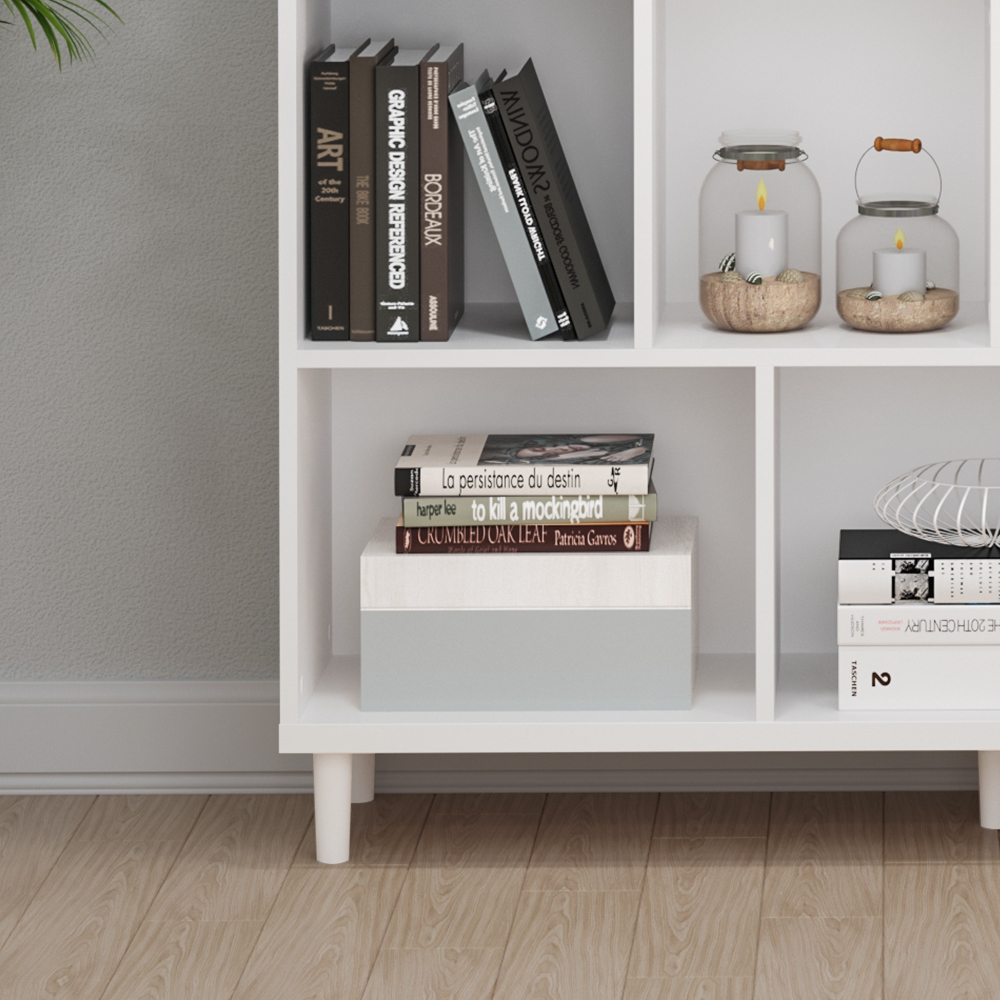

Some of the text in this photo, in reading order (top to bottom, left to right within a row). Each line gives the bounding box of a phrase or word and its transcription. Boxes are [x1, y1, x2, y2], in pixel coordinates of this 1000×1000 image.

[388, 89, 406, 149] GRAPHIC
[317, 127, 343, 171] ART
[356, 175, 369, 188] THE
[388, 151, 406, 200] DESIGN
[424, 174, 442, 245] BORDEAUX
[388, 203, 406, 290] REFERENCED
[429, 295, 438, 330] ASSOULINE
[442, 468, 455, 489] La
[459, 468, 524, 496] persistance
[528, 467, 543, 489] du
[547, 467, 581, 489] destin
[417, 495, 603, 524] harper lee to kill a mockingbird
[417, 525, 485, 545] CRUMBLED
[488, 525, 516, 545] OAK
[518, 525, 547, 544] LEAF
[554, 529, 585, 546] Patricia
[587, 529, 617, 546] Gavros
[905, 618, 955, 632] CENTURY
[957, 618, 985, 632] 20TH
[872, 671, 891, 687] 2
